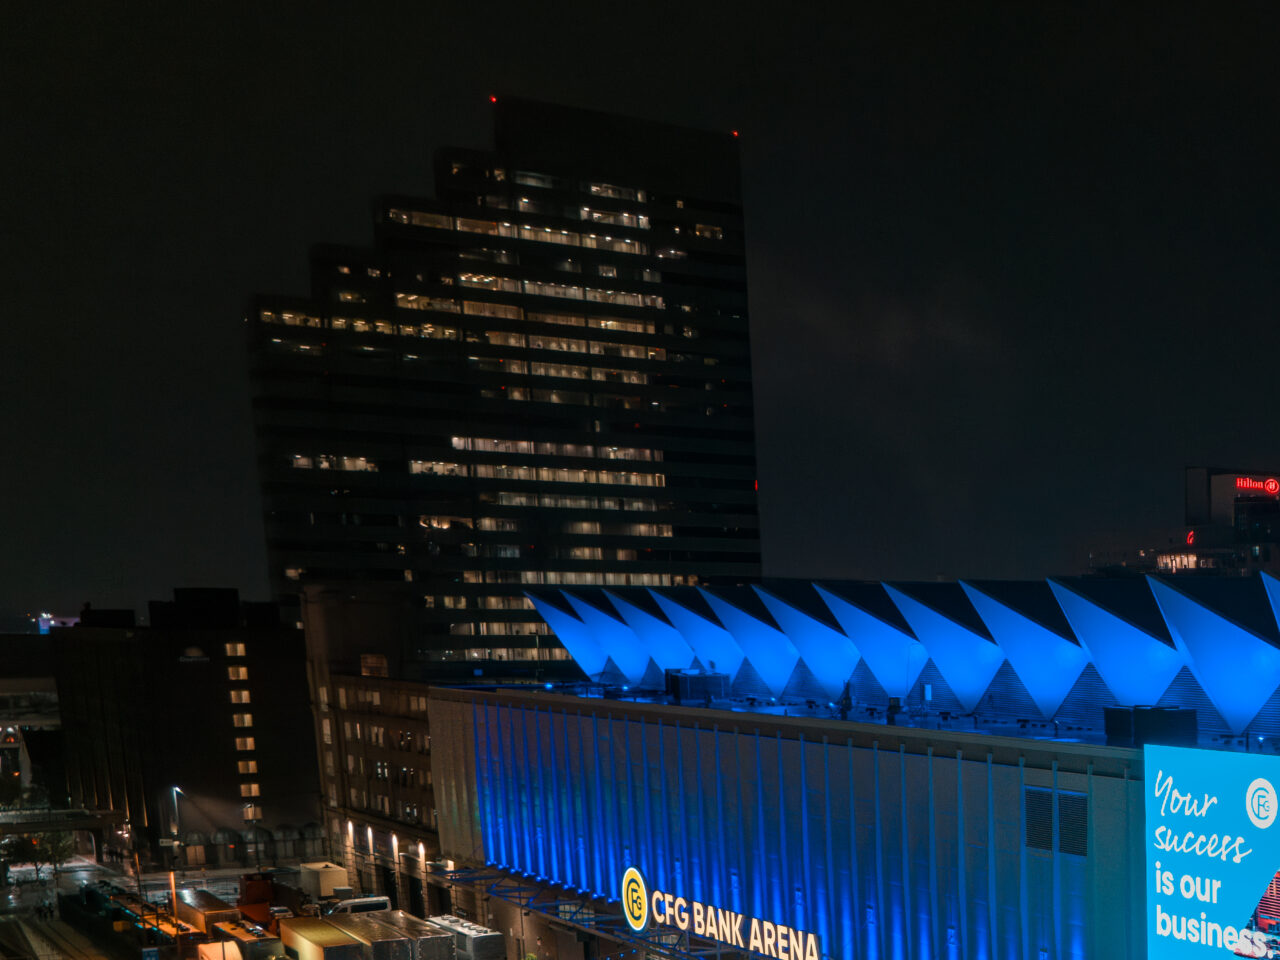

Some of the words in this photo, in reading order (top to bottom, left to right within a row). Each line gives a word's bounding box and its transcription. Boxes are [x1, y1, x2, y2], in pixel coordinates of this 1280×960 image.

[1236, 477, 1264, 489] Hilton
[1154, 770, 1218, 817] Your
[1154, 825, 1253, 864] success
[1155, 861, 1175, 896] is
[1179, 872, 1222, 904] our
[651, 889, 690, 931] CFG
[692, 900, 745, 949] BANK
[1156, 904, 1275, 959] business.
